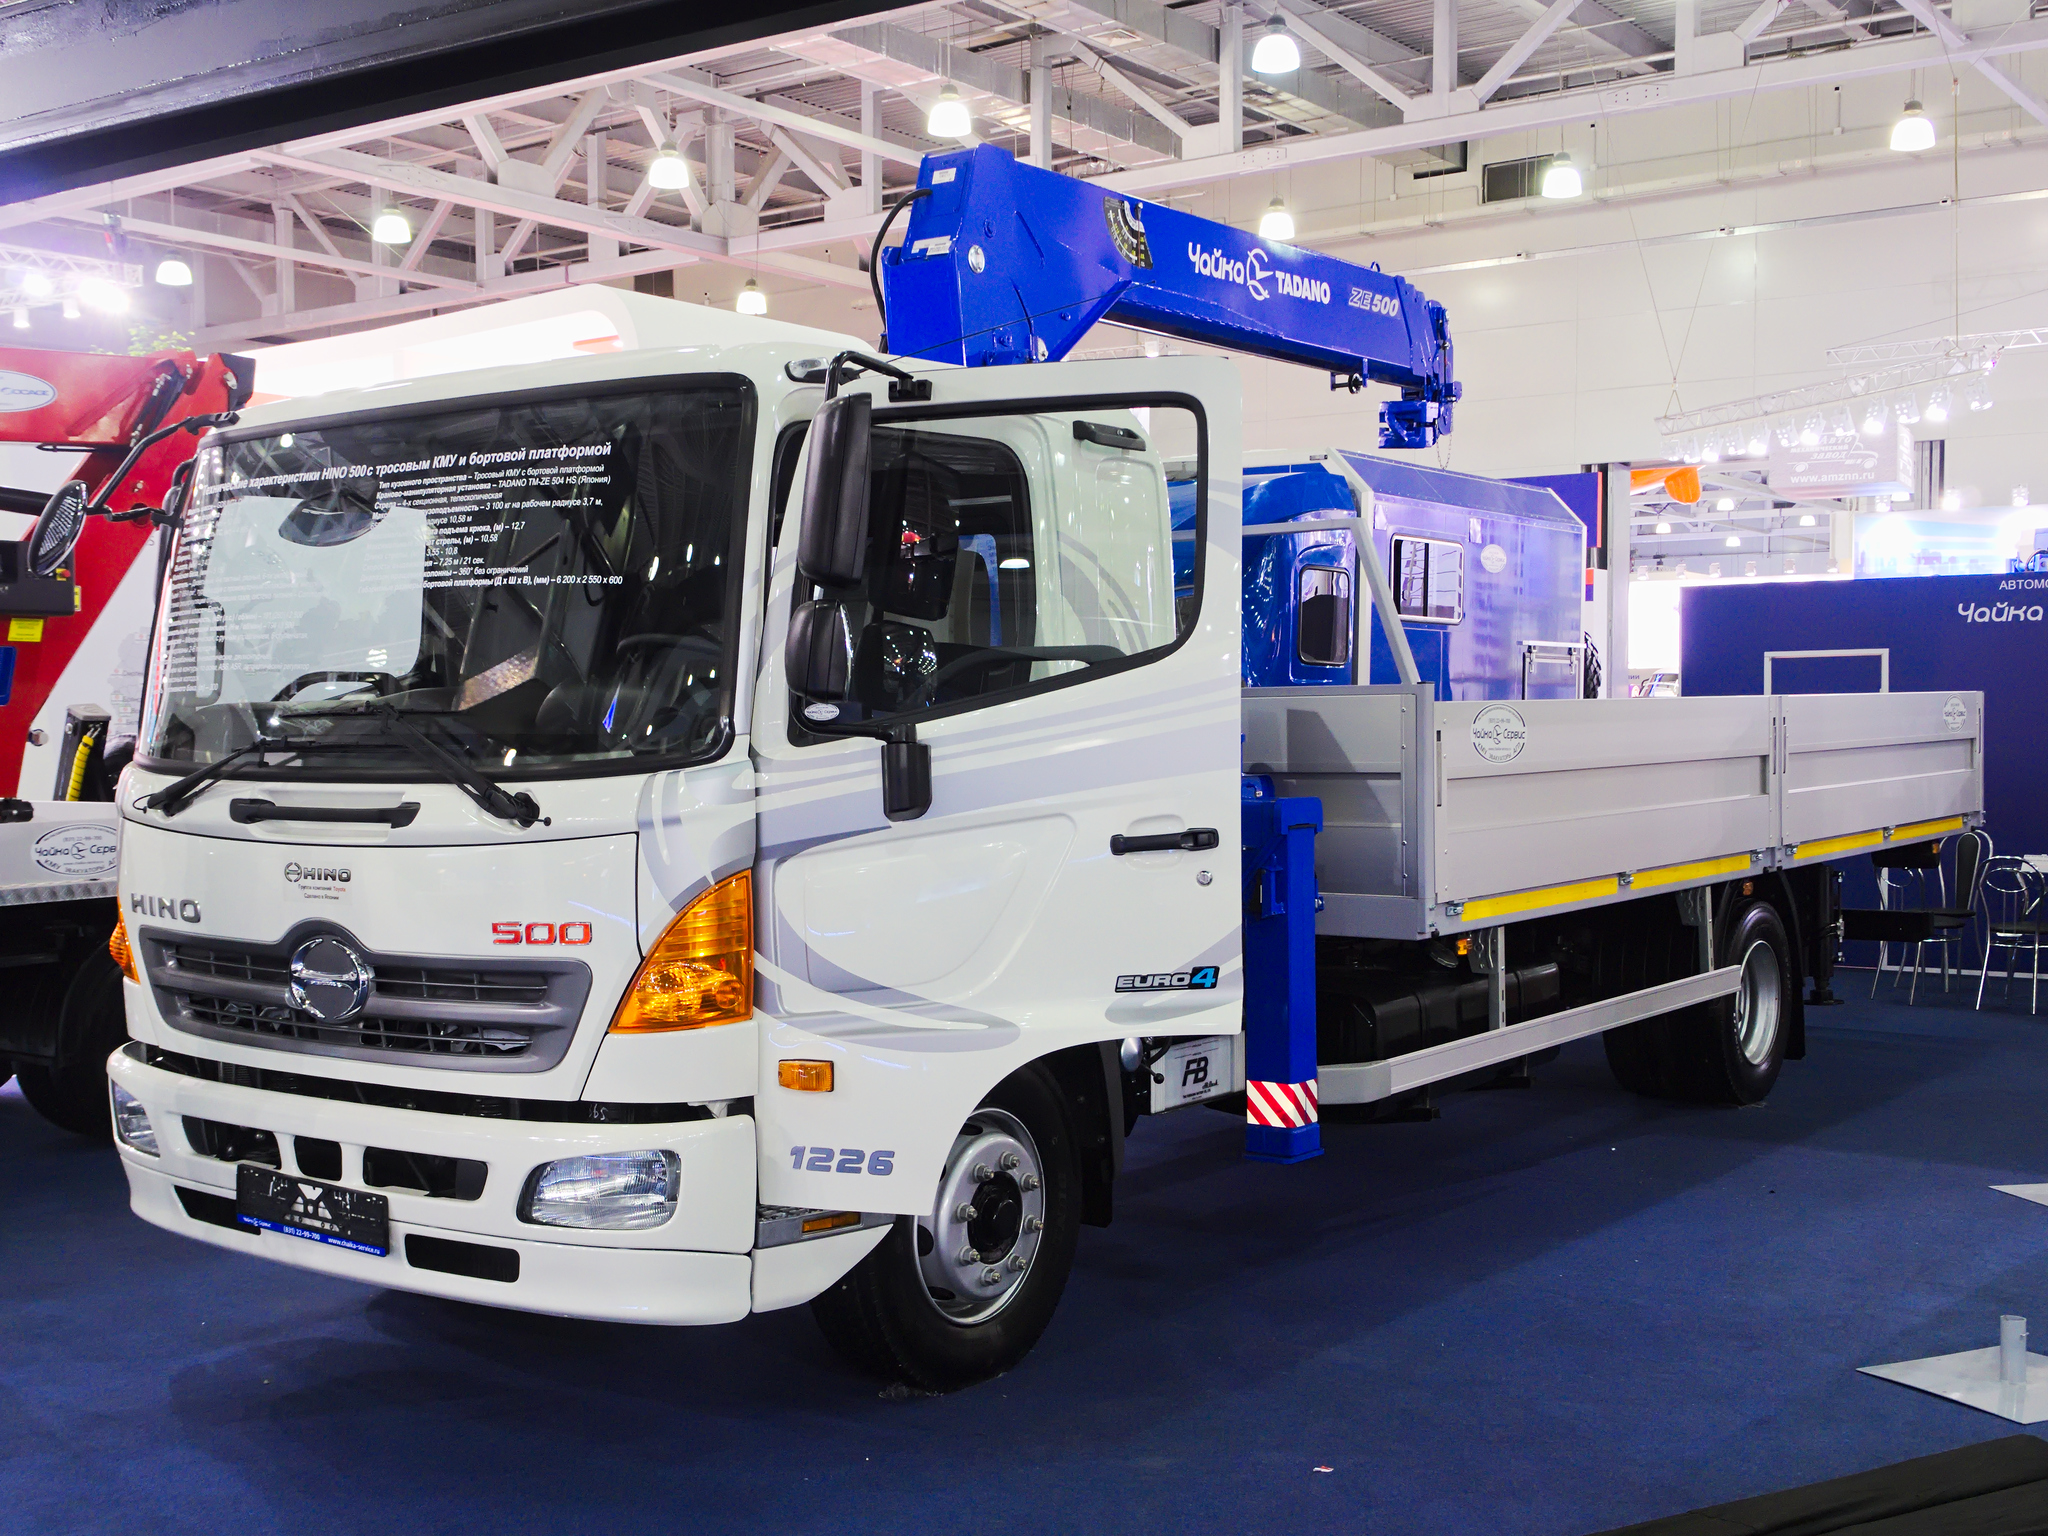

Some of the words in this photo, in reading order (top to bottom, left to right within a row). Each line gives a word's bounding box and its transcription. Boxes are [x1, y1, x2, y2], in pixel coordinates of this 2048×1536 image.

[1187, 242, 1245, 284] Чайка
[1275, 271, 1331, 305] TADANO
[249, 471, 320, 490] характеристики
[321, 466, 348, 481] HINO
[376, 460, 430, 477] тросовым
[432, 454, 458, 469] КМУ
[458, 456, 467, 466] и
[469, 447, 526, 466] бортовой
[528, 441, 612, 460] платформой
[505, 468, 521, 477] КМУ
[527, 466, 558, 476] бортовой
[559, 464, 605, 475] платформой
[498, 478, 527, 488] TADANO
[566, 475, 577, 484] HS
[1790, 471, 1875, 484] www.amznn.ru
[1957, 602, 2044, 623] Чайка
[90, 844, 117, 855] Серв
[303, 867, 351, 882] HINO
[131, 893, 201, 923] HINO
[491, 921, 593, 945] 500
[790, 1145, 895, 1176] 1226
